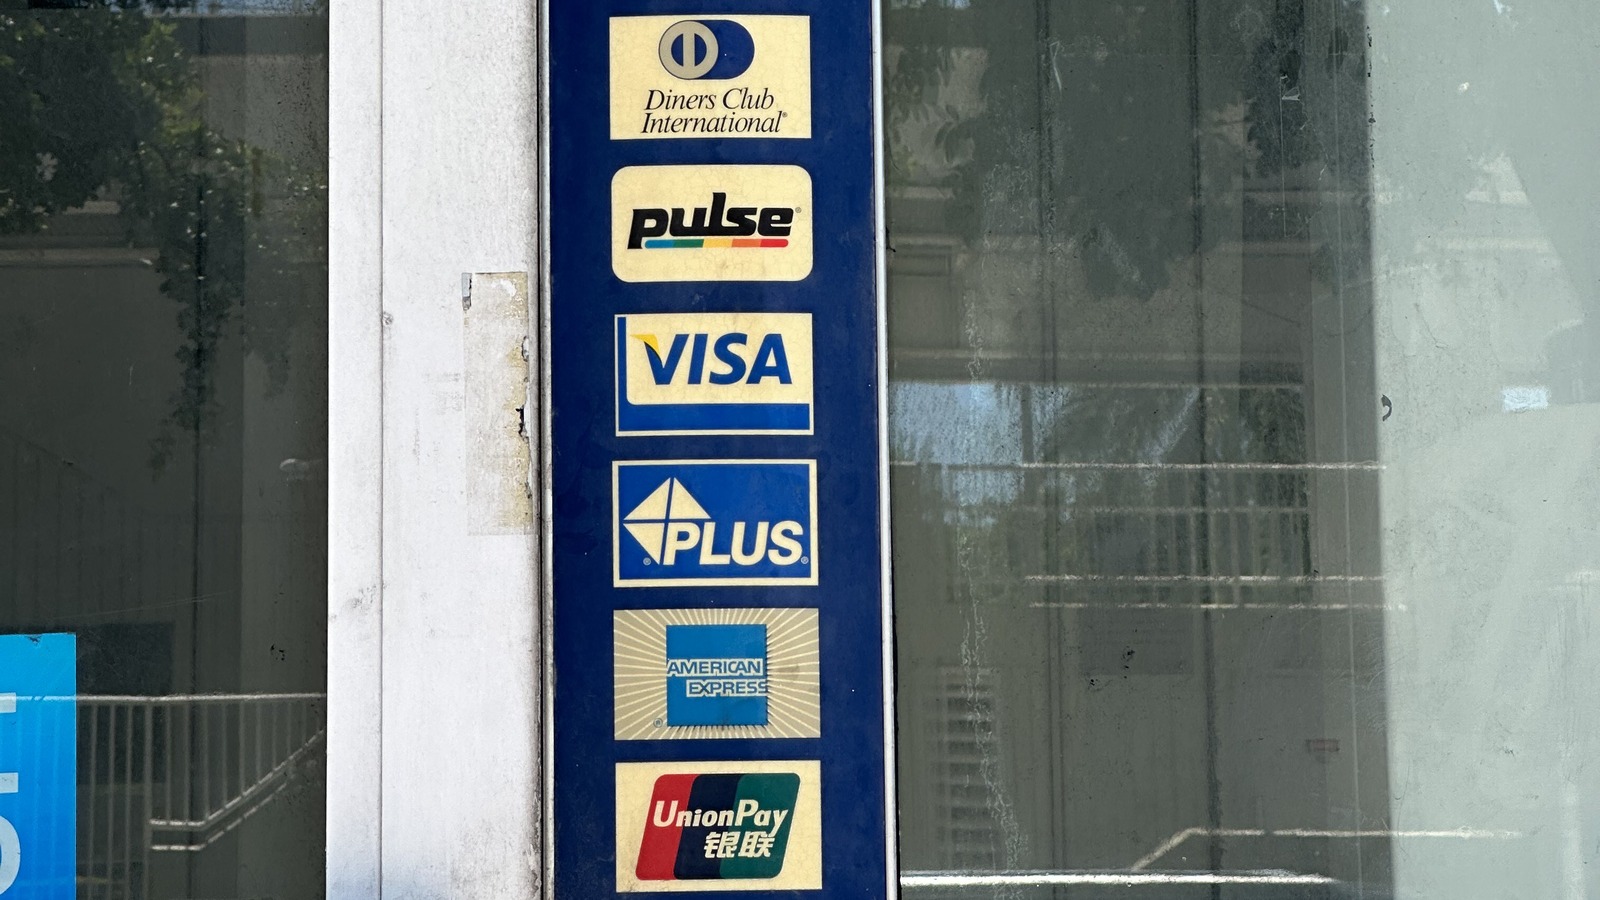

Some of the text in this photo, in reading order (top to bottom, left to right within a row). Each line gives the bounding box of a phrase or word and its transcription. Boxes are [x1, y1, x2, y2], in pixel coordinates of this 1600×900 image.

[644, 87, 775, 111] Diners Club
[641, 110, 783, 134] International
[627, 192, 794, 249] pulse
[630, 332, 793, 385] VISA
[662, 520, 804, 566] PLUS
[667, 658, 763, 677] AMERICAN
[686, 679, 768, 697] EXPRESS
[653, 799, 788, 837] UnionPay
[704, 831, 776, 858] 银联
